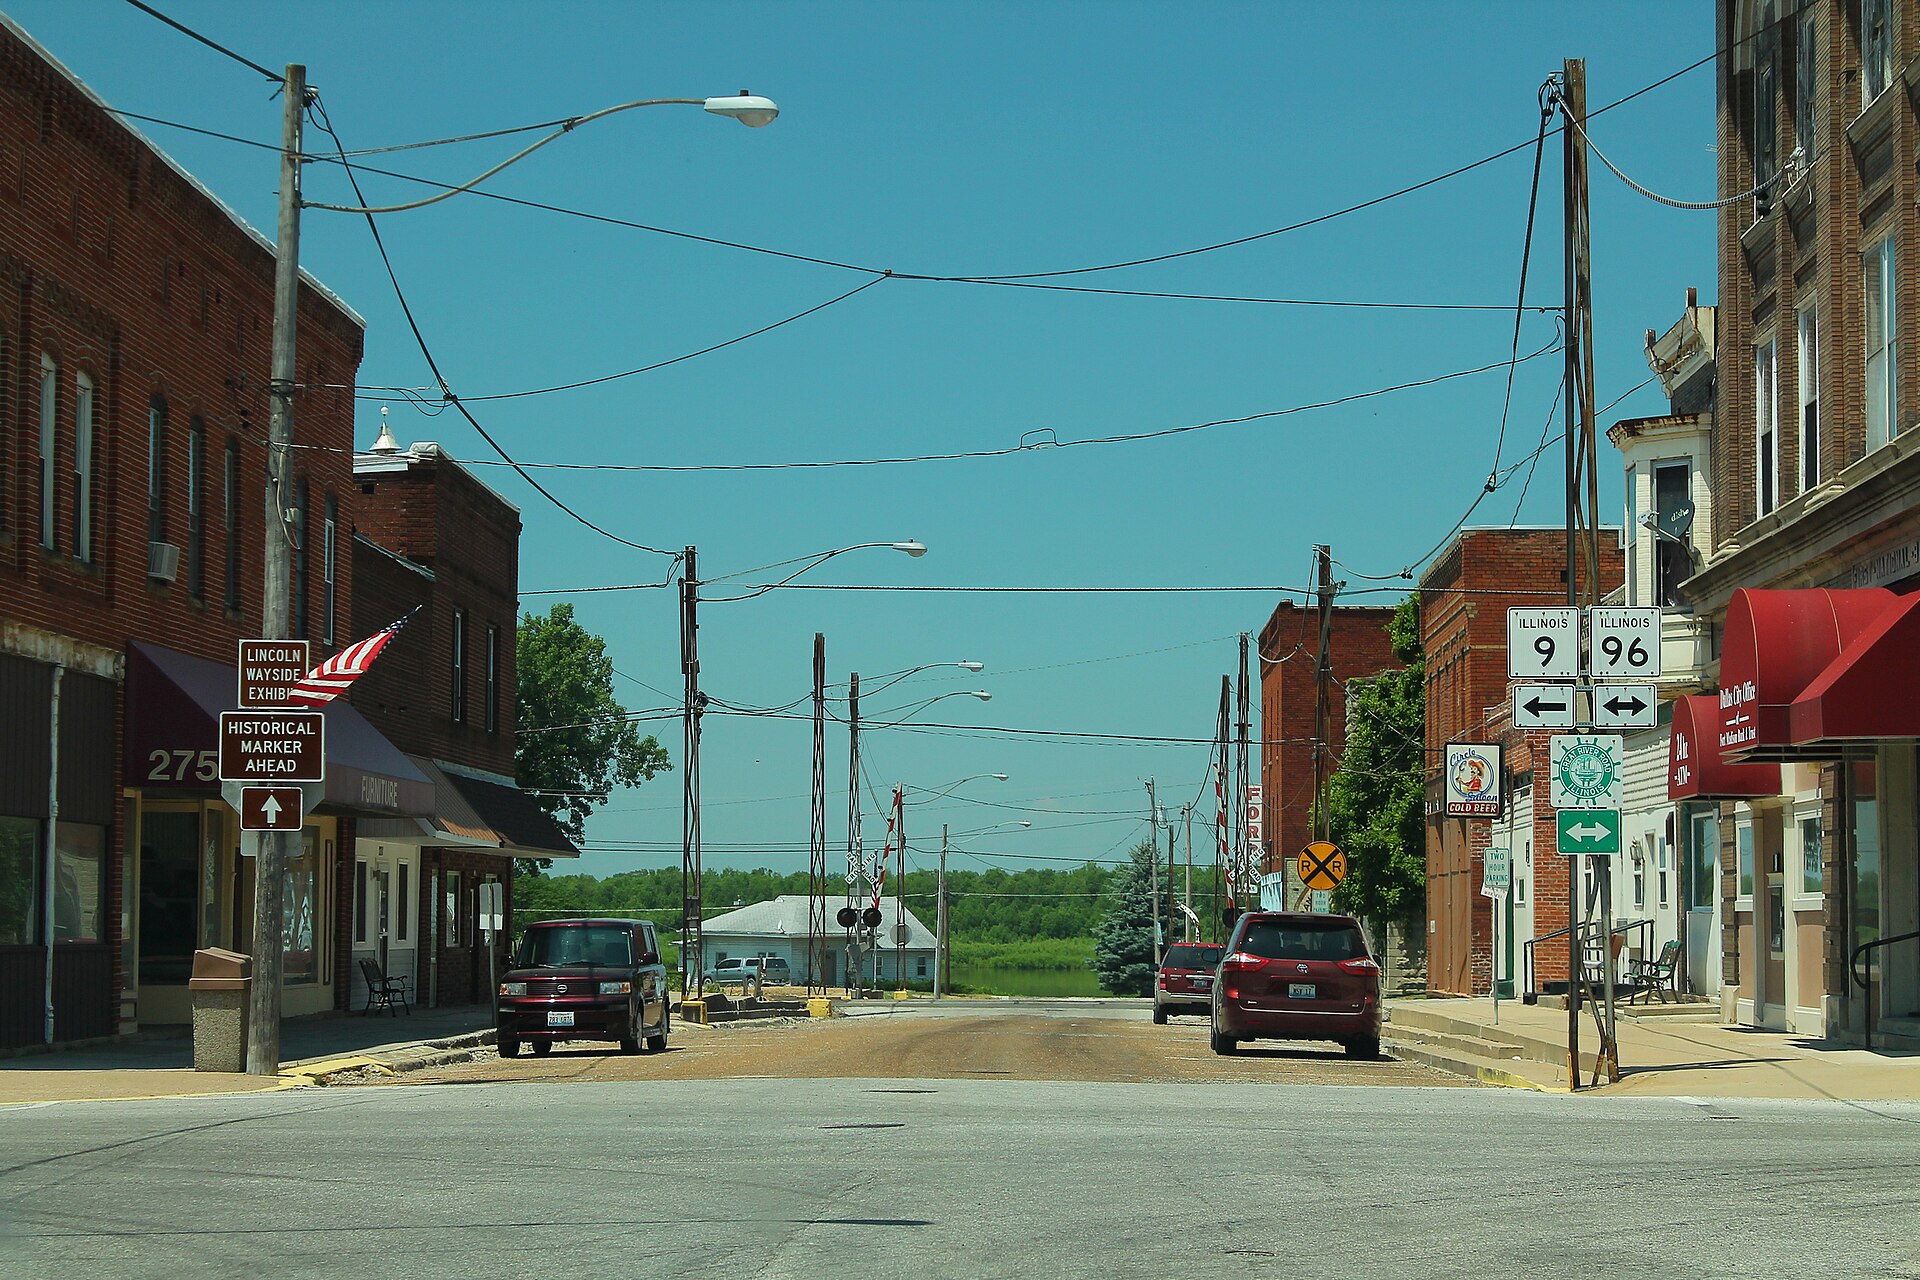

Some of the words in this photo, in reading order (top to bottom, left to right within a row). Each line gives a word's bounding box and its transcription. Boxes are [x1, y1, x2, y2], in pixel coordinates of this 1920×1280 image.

[1519, 618, 1568, 629] ILLINOIS
[1600, 617, 1650, 628] ILLINOIS
[247, 648, 301, 662] LINCOLN
[1534, 635, 1556, 668] 9
[1601, 635, 1649, 667] 96
[246, 668, 301, 681] WAYSIDE
[248, 687, 292, 701] EXHIBI
[1733, 684, 1742, 708] City
[228, 721, 316, 735] HISTORICAL
[240, 740, 303, 754] MARKER
[1449, 748, 1476, 767] Circle
[1561, 750, 1577, 772] GREAT
[1577, 746, 1600, 757] RIVER
[1598, 752, 1612, 773] ROAD
[147, 749, 219, 782] 275
[244, 759, 297, 773] AHEAD
[1459, 760, 1467, 772] C
[361, 775, 398, 808] FURNITURE
[1567, 782, 1605, 797] ILLINOIS
[1465, 791, 1498, 803] Saloon
[1449, 803, 1472, 813] COLD
[1473, 803, 1497, 813] BEER
[1490, 852, 1505, 861] TWO
[1301, 860, 1311, 873] R
[1332, 860, 1342, 873] R
[1488, 863, 1505, 872] HOUR
[1486, 874, 1508, 883] PARKING
